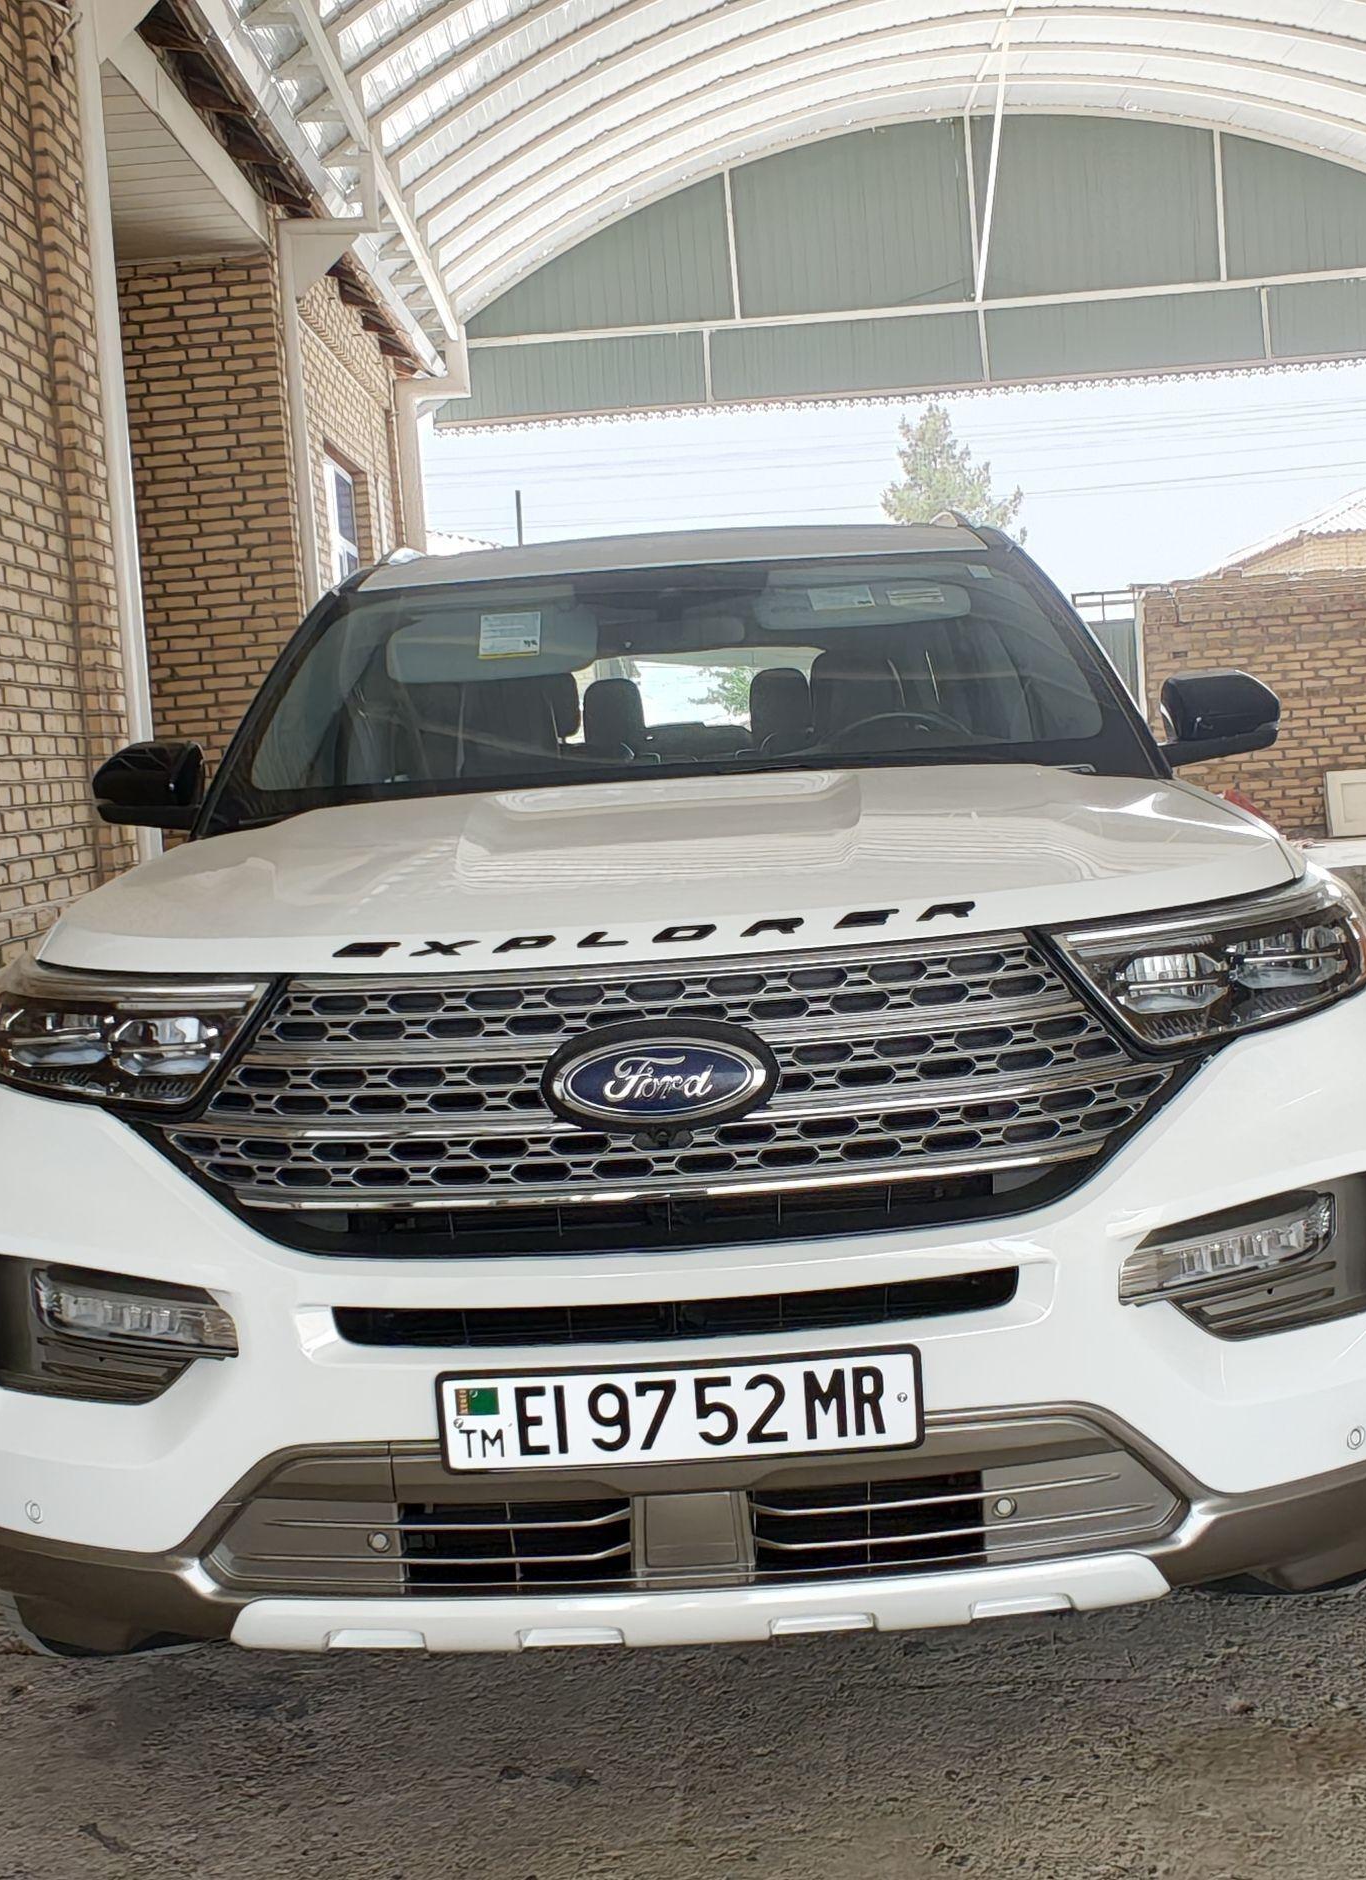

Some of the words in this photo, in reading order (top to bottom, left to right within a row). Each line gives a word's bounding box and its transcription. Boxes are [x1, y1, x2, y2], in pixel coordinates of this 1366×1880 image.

[331, 900, 976, 958] EXPLORER
[602, 1054, 714, 1102] Ford
[802, 1365, 886, 1441] MR
[458, 1427, 505, 1459] TM
